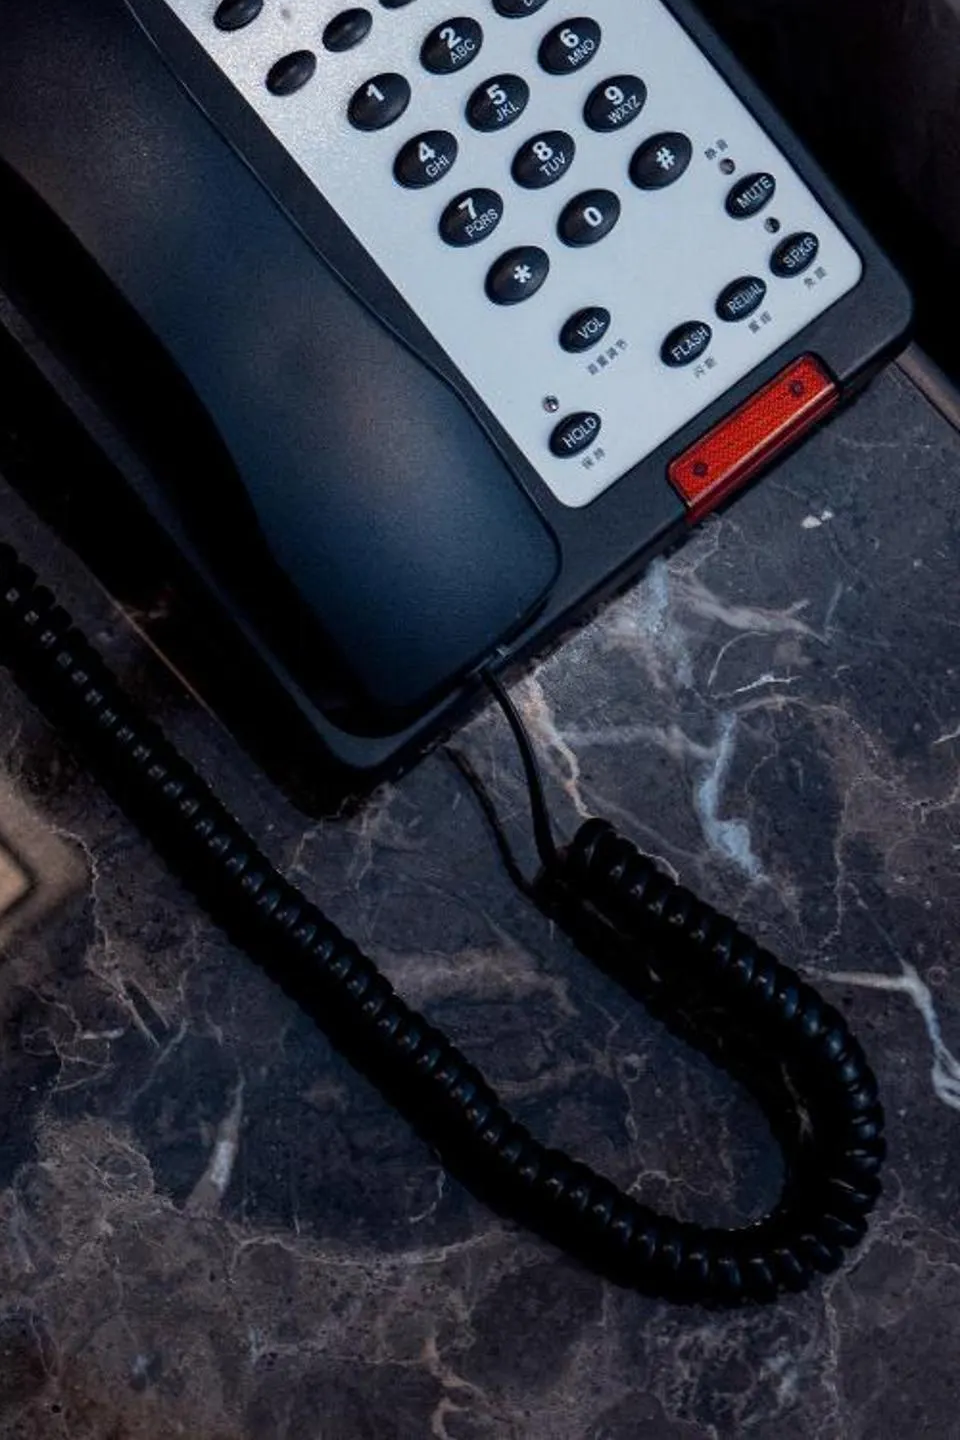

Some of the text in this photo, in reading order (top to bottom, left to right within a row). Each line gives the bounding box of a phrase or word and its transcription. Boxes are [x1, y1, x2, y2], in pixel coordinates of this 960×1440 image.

[439, 27, 461, 48] 2
[559, 28, 579, 47] 6
[450, 38, 475, 63] ABC
[567, 39, 594, 64] MNO
[366, 83, 384, 100] 1
[486, 84, 506, 104] 5
[604, 86, 624, 105] 9
[496, 101, 520, 121] JKL
[607, 95, 640, 123] WXYZ
[419, 142, 435, 162] 4
[532, 141, 553, 161] 8
[425, 154, 449, 177] GHI
[539, 151, 565, 176] TUV
[736, 175, 772, 208] MUTE
[458, 197, 477, 219] 7
[583, 206, 602, 226] 0
[465, 208, 498, 237] PQRS
[782, 236, 816, 267] SPKR
[577, 317, 605, 338] VOL
[671, 326, 708, 360] FLASH
[562, 417, 596, 447] HOLD
